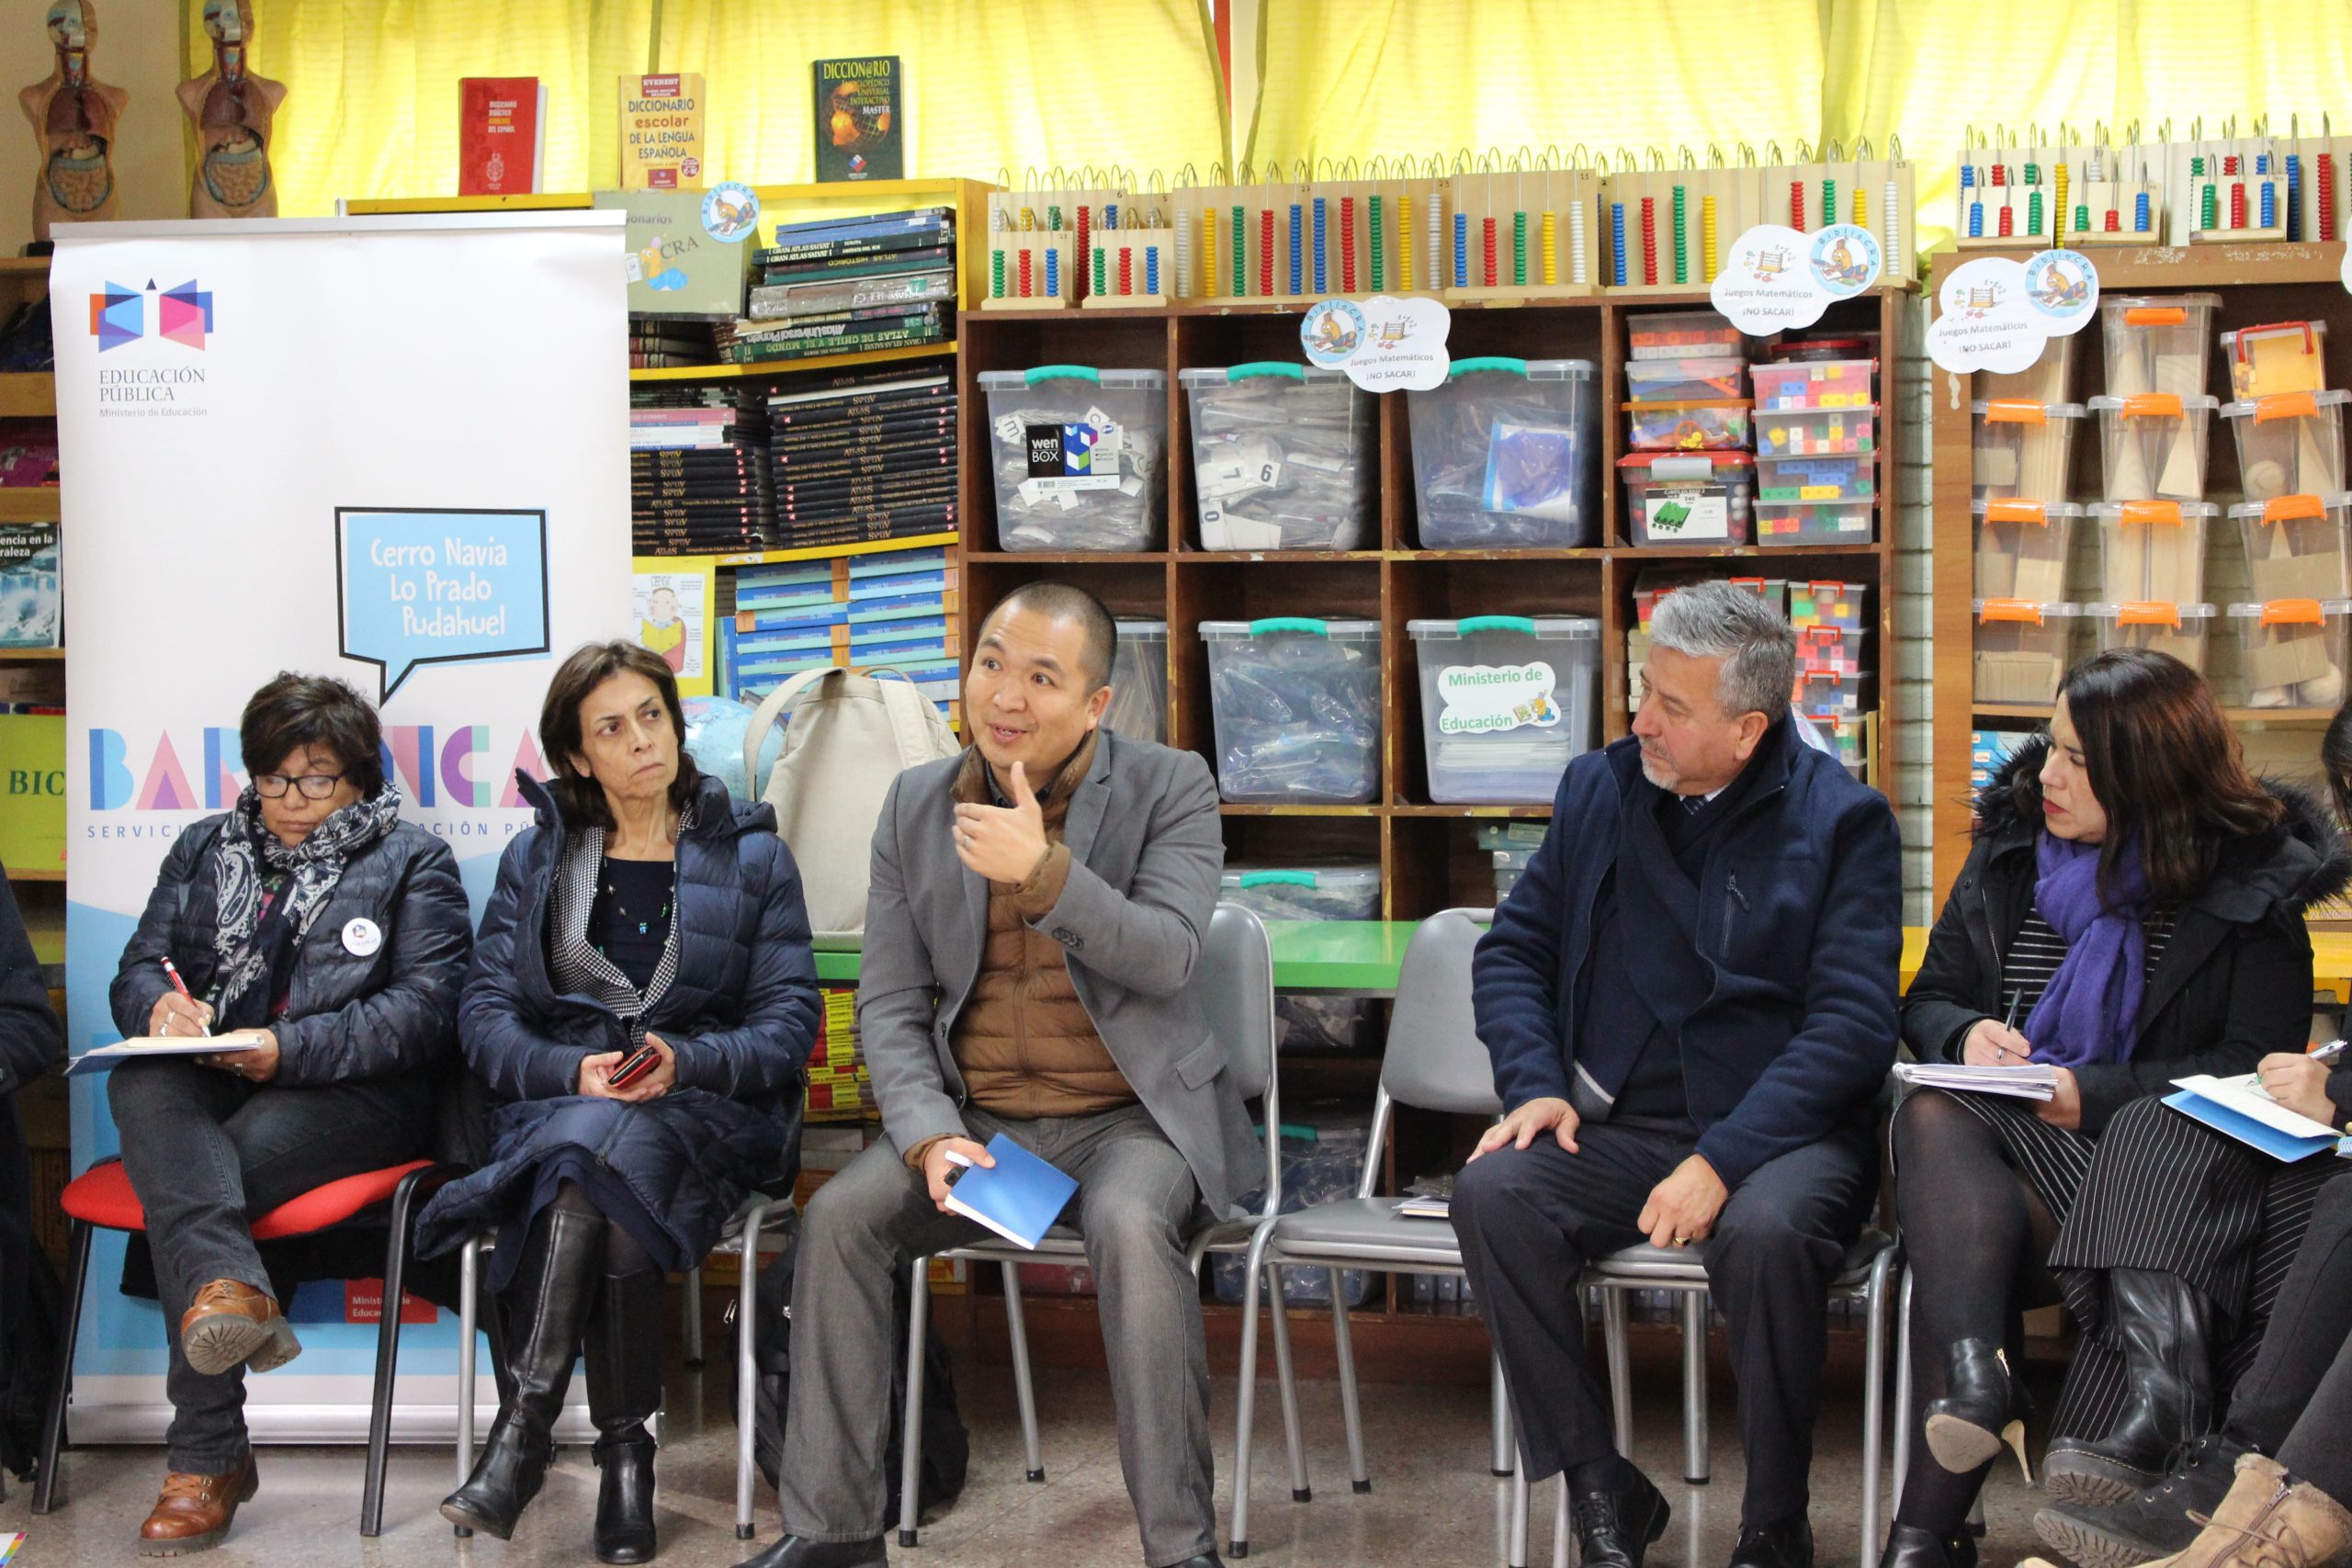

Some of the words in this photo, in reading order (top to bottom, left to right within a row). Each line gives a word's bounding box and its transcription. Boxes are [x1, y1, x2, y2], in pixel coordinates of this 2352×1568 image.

[823, 60, 890, 79] DICCION@RIO
[643, 78, 679, 86] EVEREST
[857, 87, 889, 96] UNIVERSAL
[628, 98, 695, 112] DICCIONARIO
[862, 105, 891, 114] MASTER
[635, 115, 689, 129] escolar
[629, 134, 641, 144] DE
[644, 133, 655, 143] LA
[658, 132, 695, 143] LENGUA
[639, 144, 687, 159] ESPAÑOLA
[627, 212, 673, 225] ionarios
[660, 236, 698, 259] CRA
[1818, 227, 1877, 267] BiblioCRA
[770, 254, 788, 263] GRAN
[788, 253, 808, 261] ATLAS
[2029, 252, 2093, 280] BiblioCRA
[1724, 289, 1754, 299] Juegos
[1756, 288, 1813, 299] Matemáticos
[1306, 301, 1364, 333] BiblioCRA
[781, 326, 821, 341] Universal
[821, 324, 845, 335] Atlas
[877, 330, 910, 341] ATLAS
[1939, 327, 1968, 337] Juegos
[1970, 321, 2028, 333] Matemáticos
[803, 339, 816, 348] EL
[819, 338, 828, 346] Y
[828, 334, 859, 345] CHILE
[862, 334, 875, 343] DE
[765, 341, 800, 353] MUNDO
[1351, 357, 1377, 367] Juegos
[1379, 353, 1433, 363] Matemáticos
[100, 366, 205, 384] EDUCACIÓN
[100, 384, 175, 402] PÚBLICA
[100, 408, 145, 418] Ministerio
[148, 408, 159, 417] de
[161, 407, 208, 417] Educación
[1032, 438, 1058, 449] wen
[1032, 450, 1059, 463] BOX
[1261, 464, 1273, 483] 6
[0, 535, 27, 546] encia
[29, 536, 41, 545] en
[44, 534, 53, 544] la
[0, 547, 30, 557] raleza
[370, 537, 436, 568] Cerro
[445, 536, 508, 566] Navia
[390, 572, 416, 602] Lo
[426, 570, 492, 603] Prado
[402, 604, 505, 637] Pudahuel
[1448, 671, 1521, 687] Ministerio
[1525, 668, 1544, 682] de
[1442, 714, 1513, 730] Educación
[8, 770, 65, 795] BIC
[88, 825, 184, 839] SERVICI
[353, 1296, 383, 1304] Minist
[353, 1308, 382, 1317] Educa
